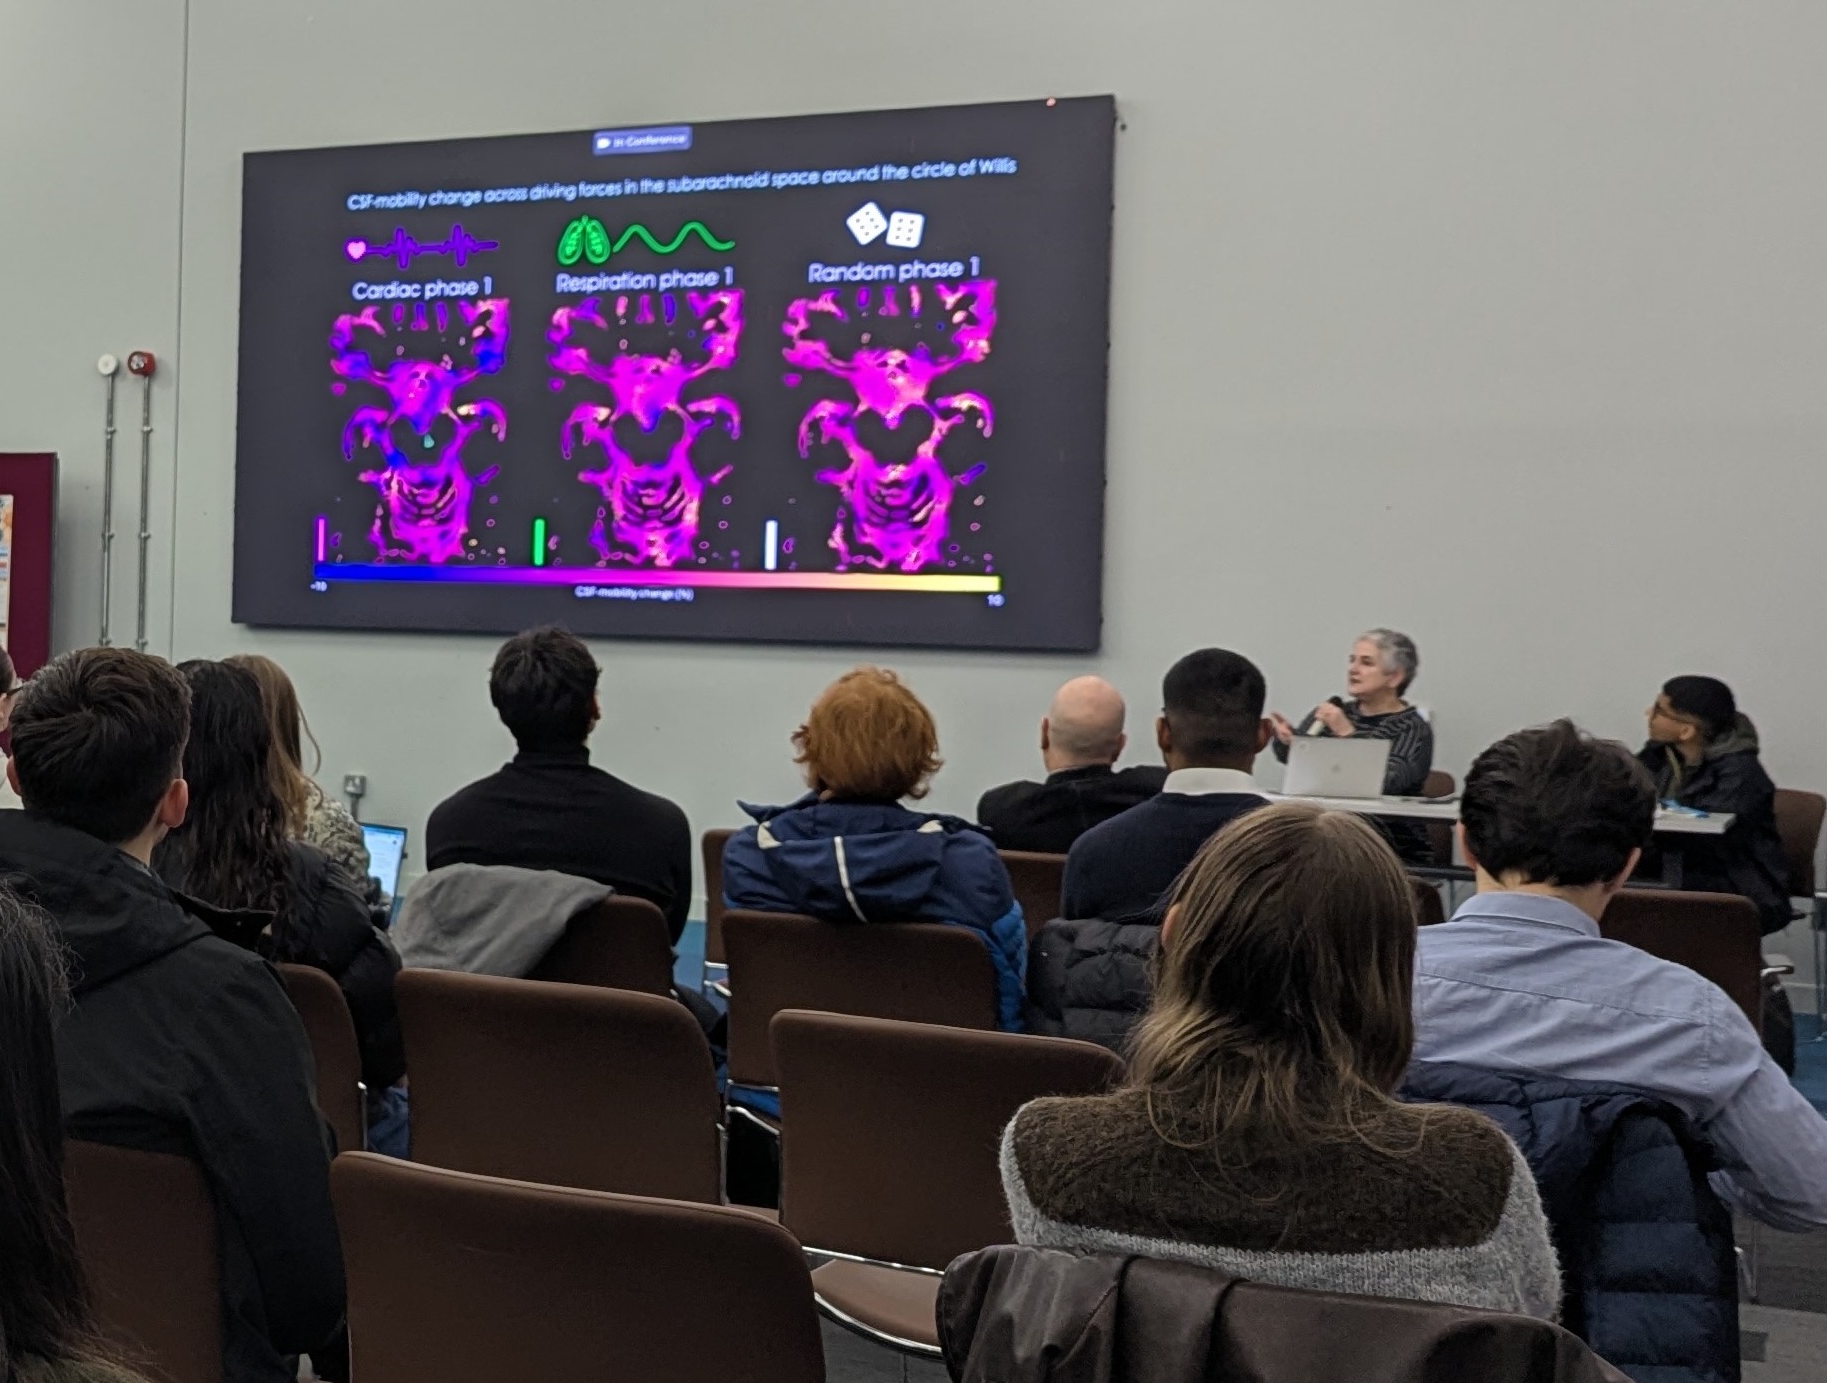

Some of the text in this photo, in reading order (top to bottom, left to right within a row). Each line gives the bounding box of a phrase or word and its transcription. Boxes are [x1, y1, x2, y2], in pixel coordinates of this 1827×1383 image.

[626, 134, 686, 147] Conference
[347, 156, 1018, 210] CSF-mobility change across driving forces in the subarachnoid space around the circle of Willis
[556, 265, 734, 294] Respiration phase 1
[808, 255, 980, 283] Random phase 1
[352, 275, 492, 300] Cardiac phase 1
[574, 585, 638, 600] CSF-mobility
[638, 588, 673, 601] change
[986, 594, 1005, 607] 10
